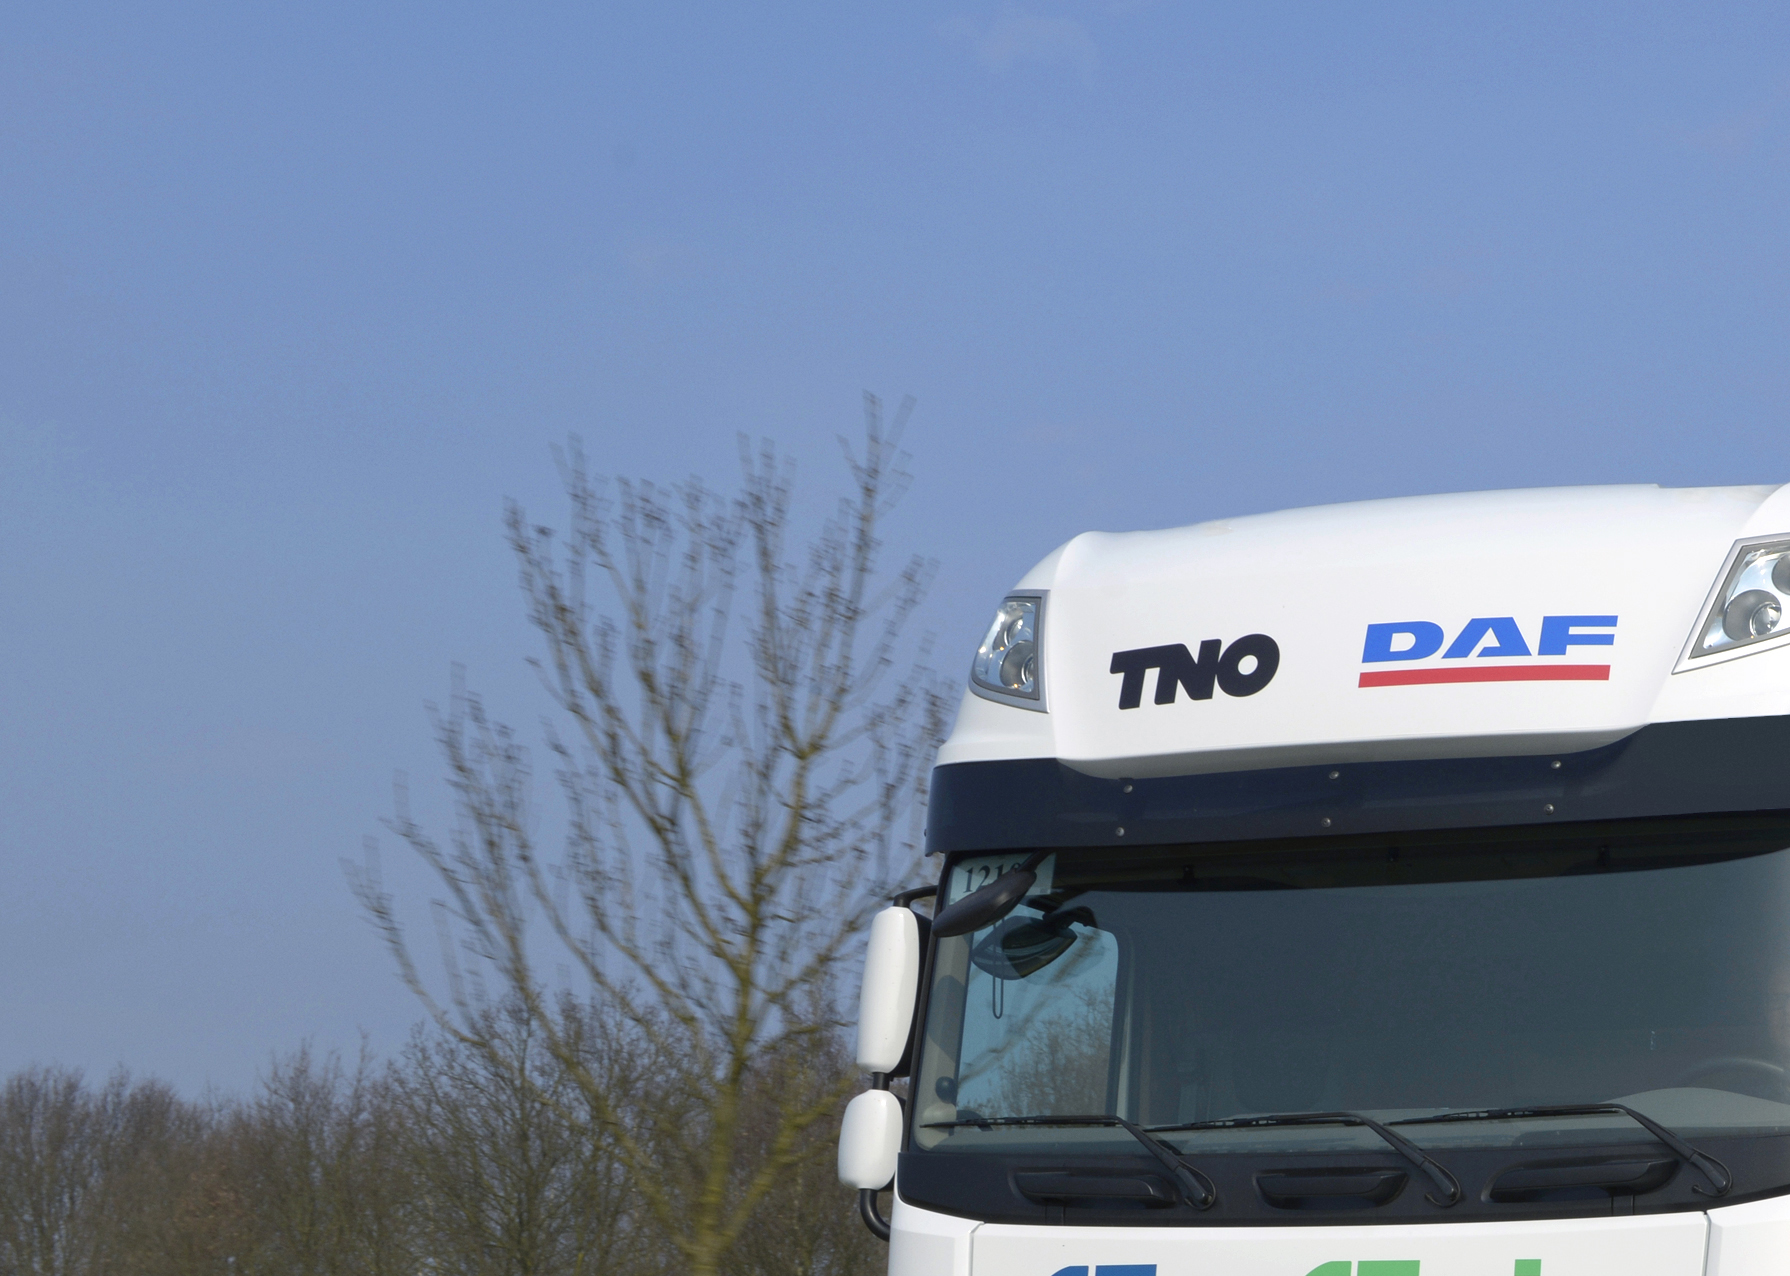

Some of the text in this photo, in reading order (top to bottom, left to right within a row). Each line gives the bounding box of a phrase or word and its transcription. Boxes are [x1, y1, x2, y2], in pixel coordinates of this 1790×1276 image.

[1362, 615, 1619, 664] DAF
[1110, 634, 1280, 710] TNO
[962, 862, 1022, 893] 121
